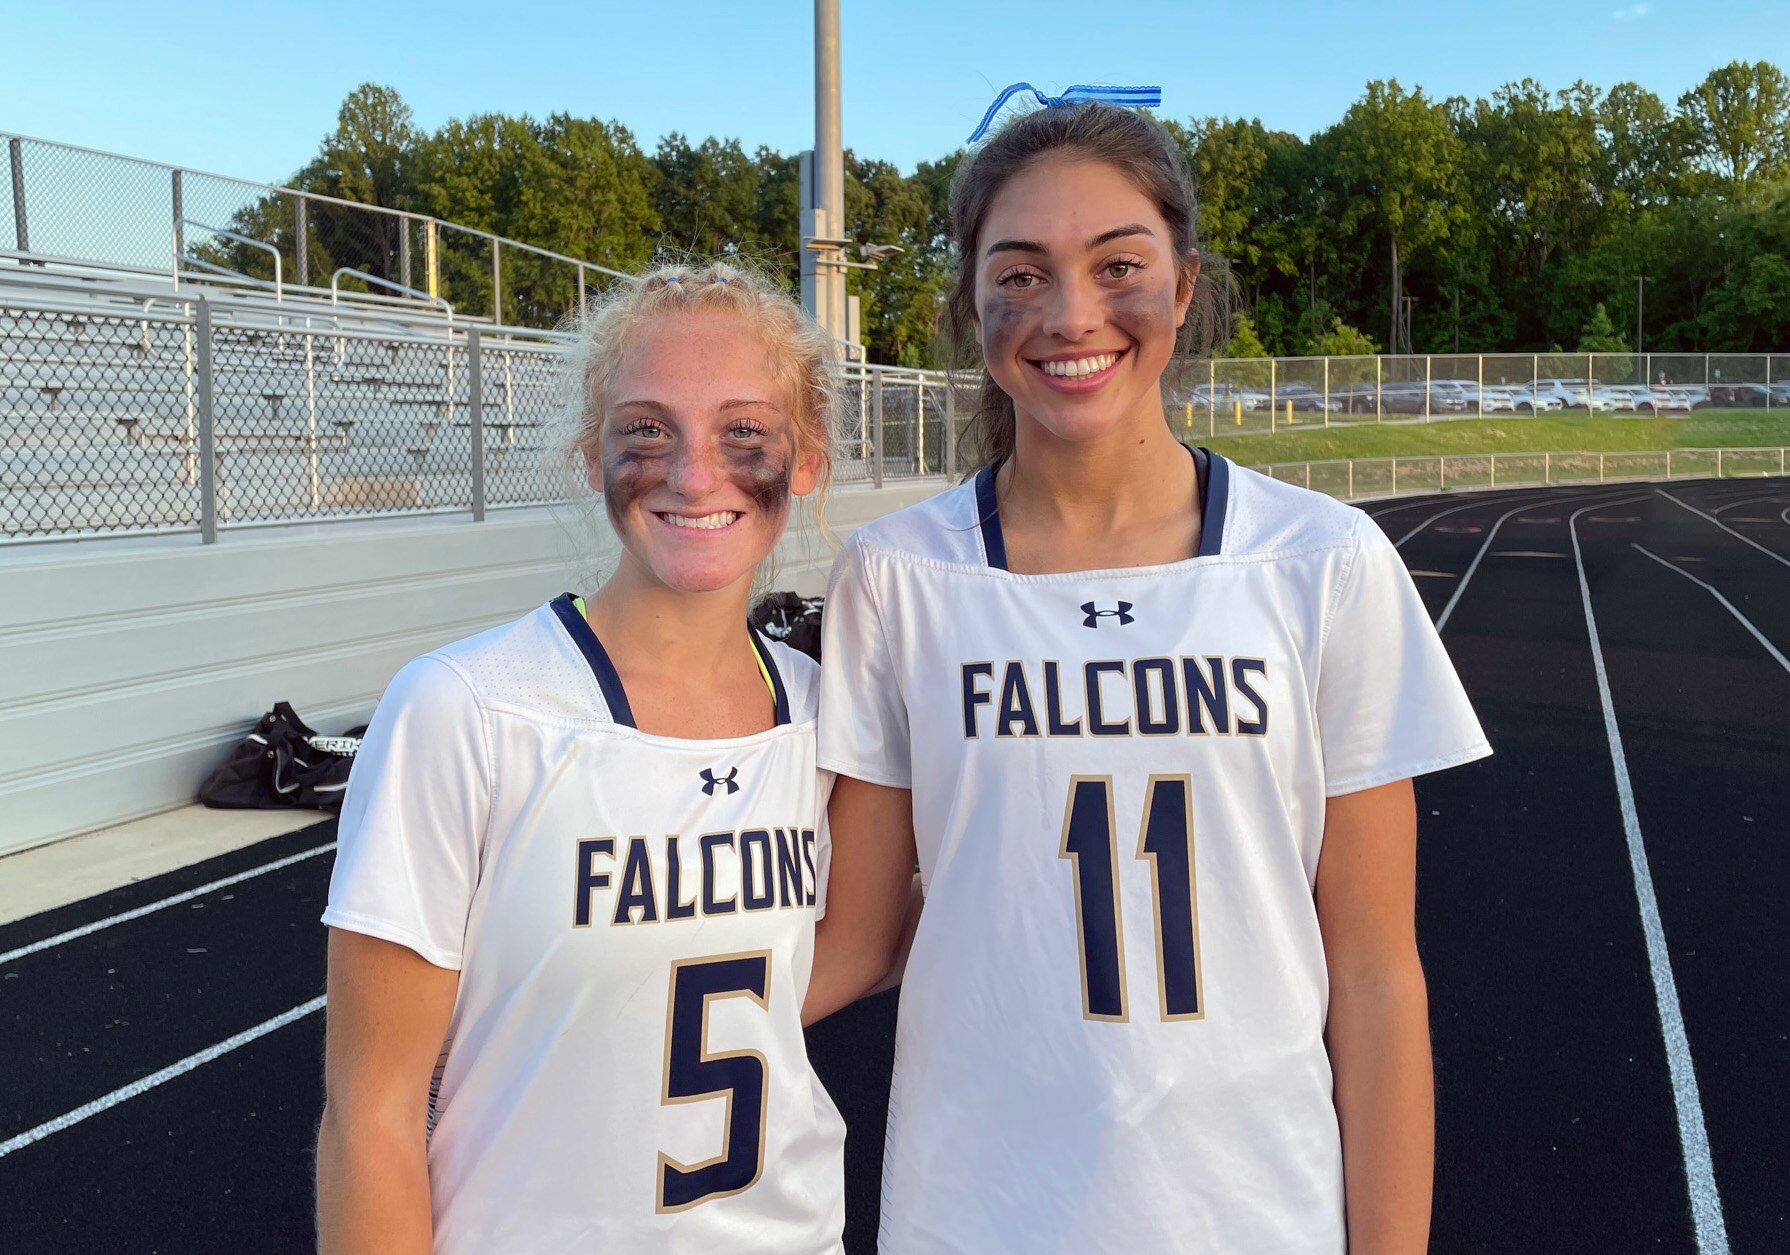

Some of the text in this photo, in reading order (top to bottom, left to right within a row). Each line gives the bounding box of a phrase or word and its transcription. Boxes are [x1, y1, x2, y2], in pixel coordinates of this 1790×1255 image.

[960, 656, 1269, 740] FALCONS
[573, 827, 816, 928] FALCONS
[1058, 774, 1205, 1023] 11
[656, 949, 772, 1214] 5
